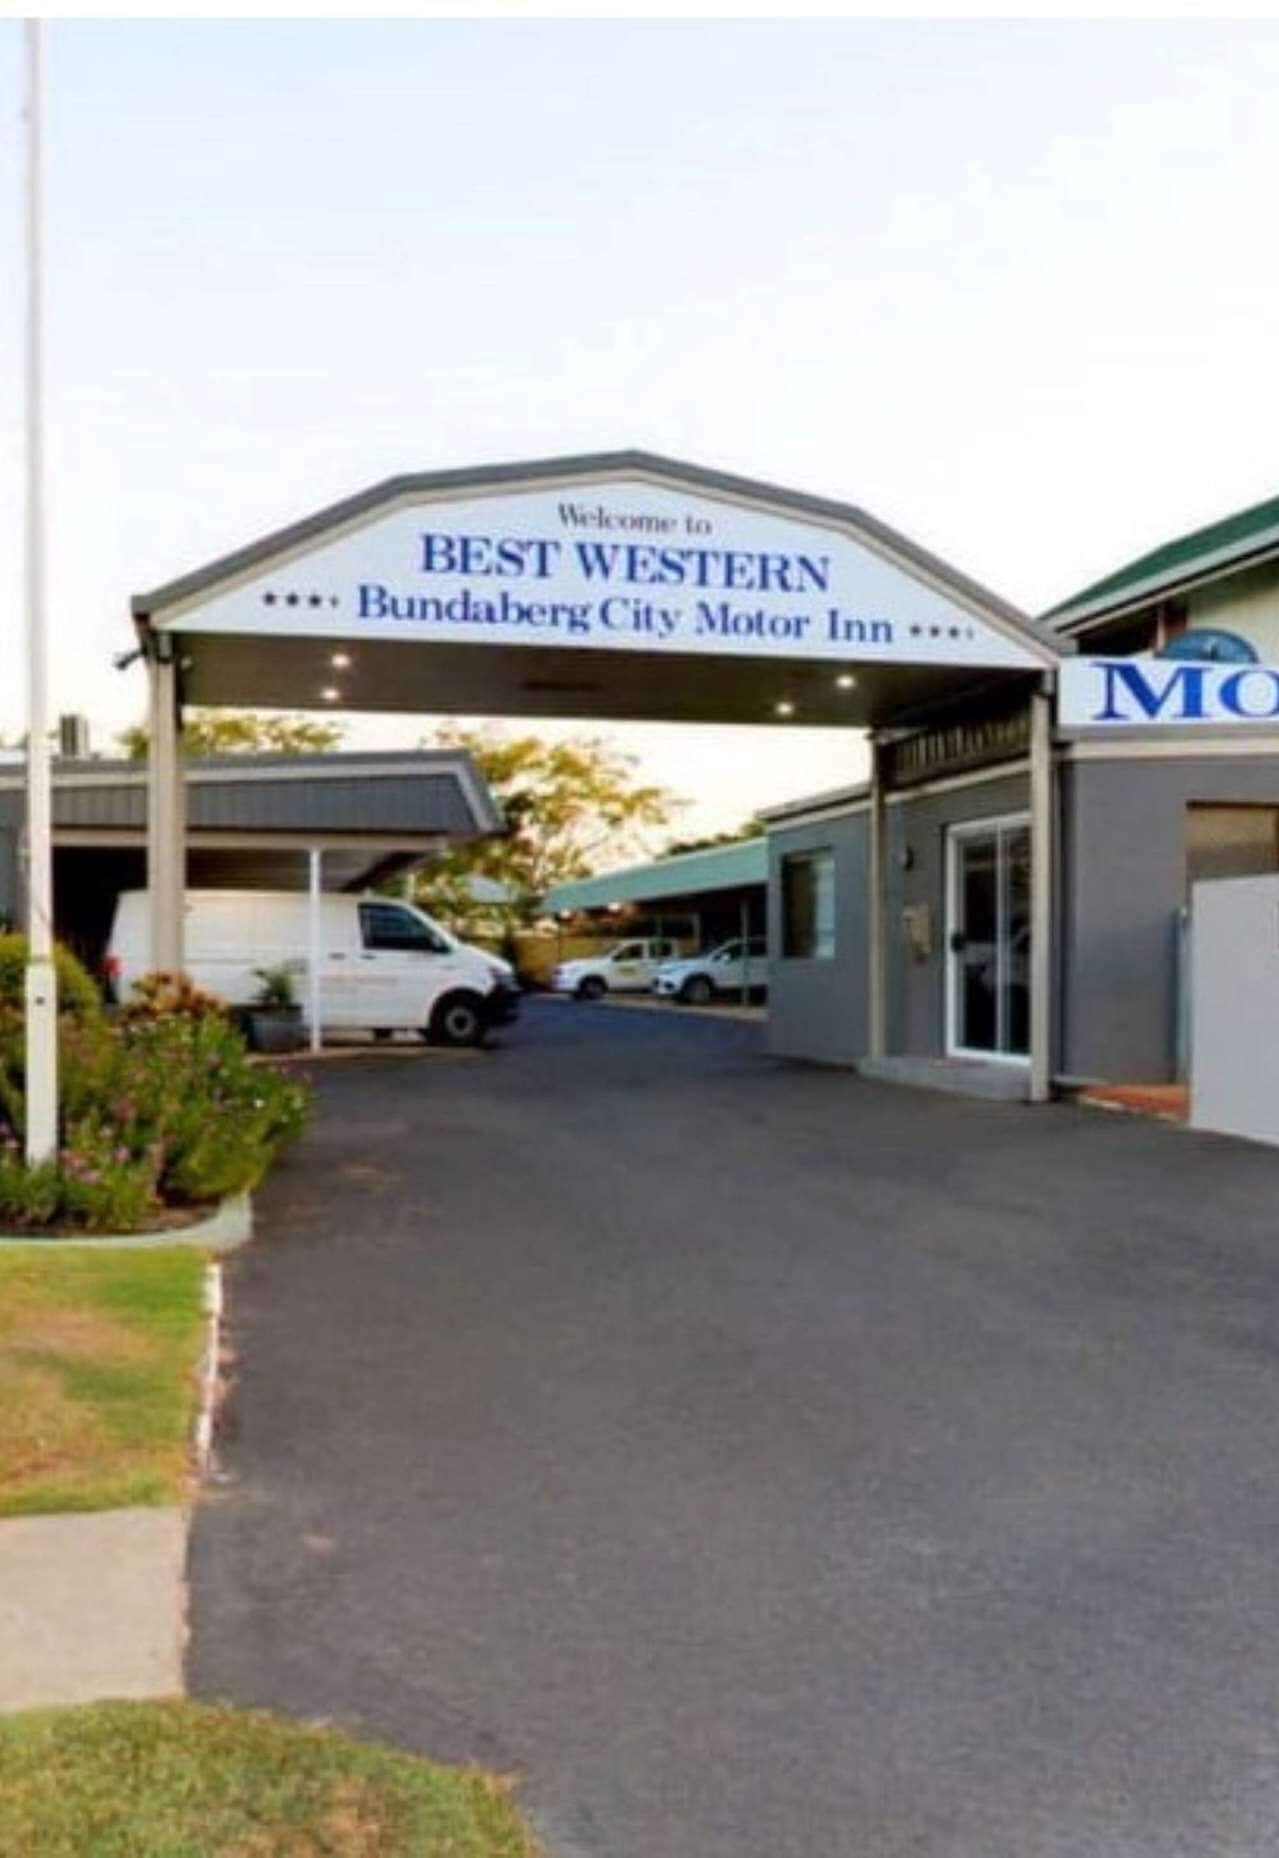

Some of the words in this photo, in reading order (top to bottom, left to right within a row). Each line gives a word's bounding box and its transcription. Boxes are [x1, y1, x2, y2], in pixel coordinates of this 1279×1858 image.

[557, 503, 676, 533] Welcome
[685, 516, 713, 535] to
[418, 533, 563, 578] BEST
[573, 542, 831, 592] WESTERN
[355, 583, 592, 632] Bundaberg
[598, 594, 683, 637] City
[692, 602, 814, 639] Motor
[825, 608, 893, 643] Inn
